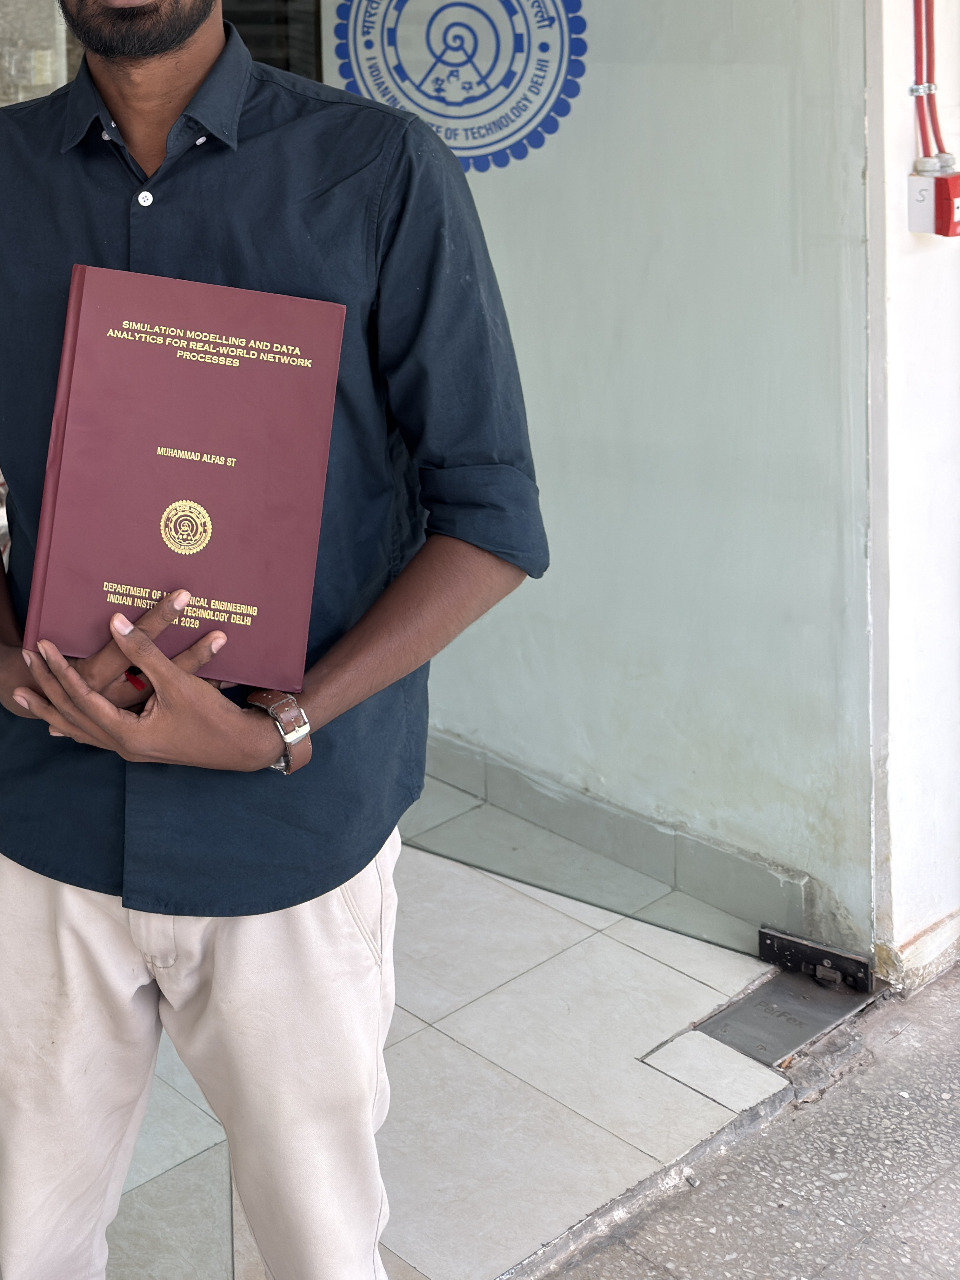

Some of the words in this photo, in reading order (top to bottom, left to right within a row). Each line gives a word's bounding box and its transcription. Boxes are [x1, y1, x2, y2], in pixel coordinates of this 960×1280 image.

[444, 127, 460, 141] OF
[463, 93, 533, 141] TECHNOLOGY
[527, 59, 550, 96] DELHI
[106, 328, 164, 344] ANALYTICS
[165, 337, 188, 348] FOR
[189, 341, 258, 359] REAL-WORLD
[259, 352, 313, 368] NETWORK
[122, 320, 184, 337] SIMULATION
[186, 330, 246, 347] MODELLING
[249, 339, 271, 351] AND
[273, 343, 301, 356] DATA
[176, 350, 240, 367] PROCESSES
[156, 446, 201, 461] MUHAMMAD
[202, 453, 225, 465] ALFAS
[226, 457, 237, 467] ST
[103, 582, 150, 599] DEPARTMENT
[151, 589, 162, 599] OF
[210, 599, 258, 616] ENGINEERING
[107, 593, 133, 606] INDIAN
[183, 606, 230, 622] TECHNOLOGY
[231, 614, 252, 626] DELHI
